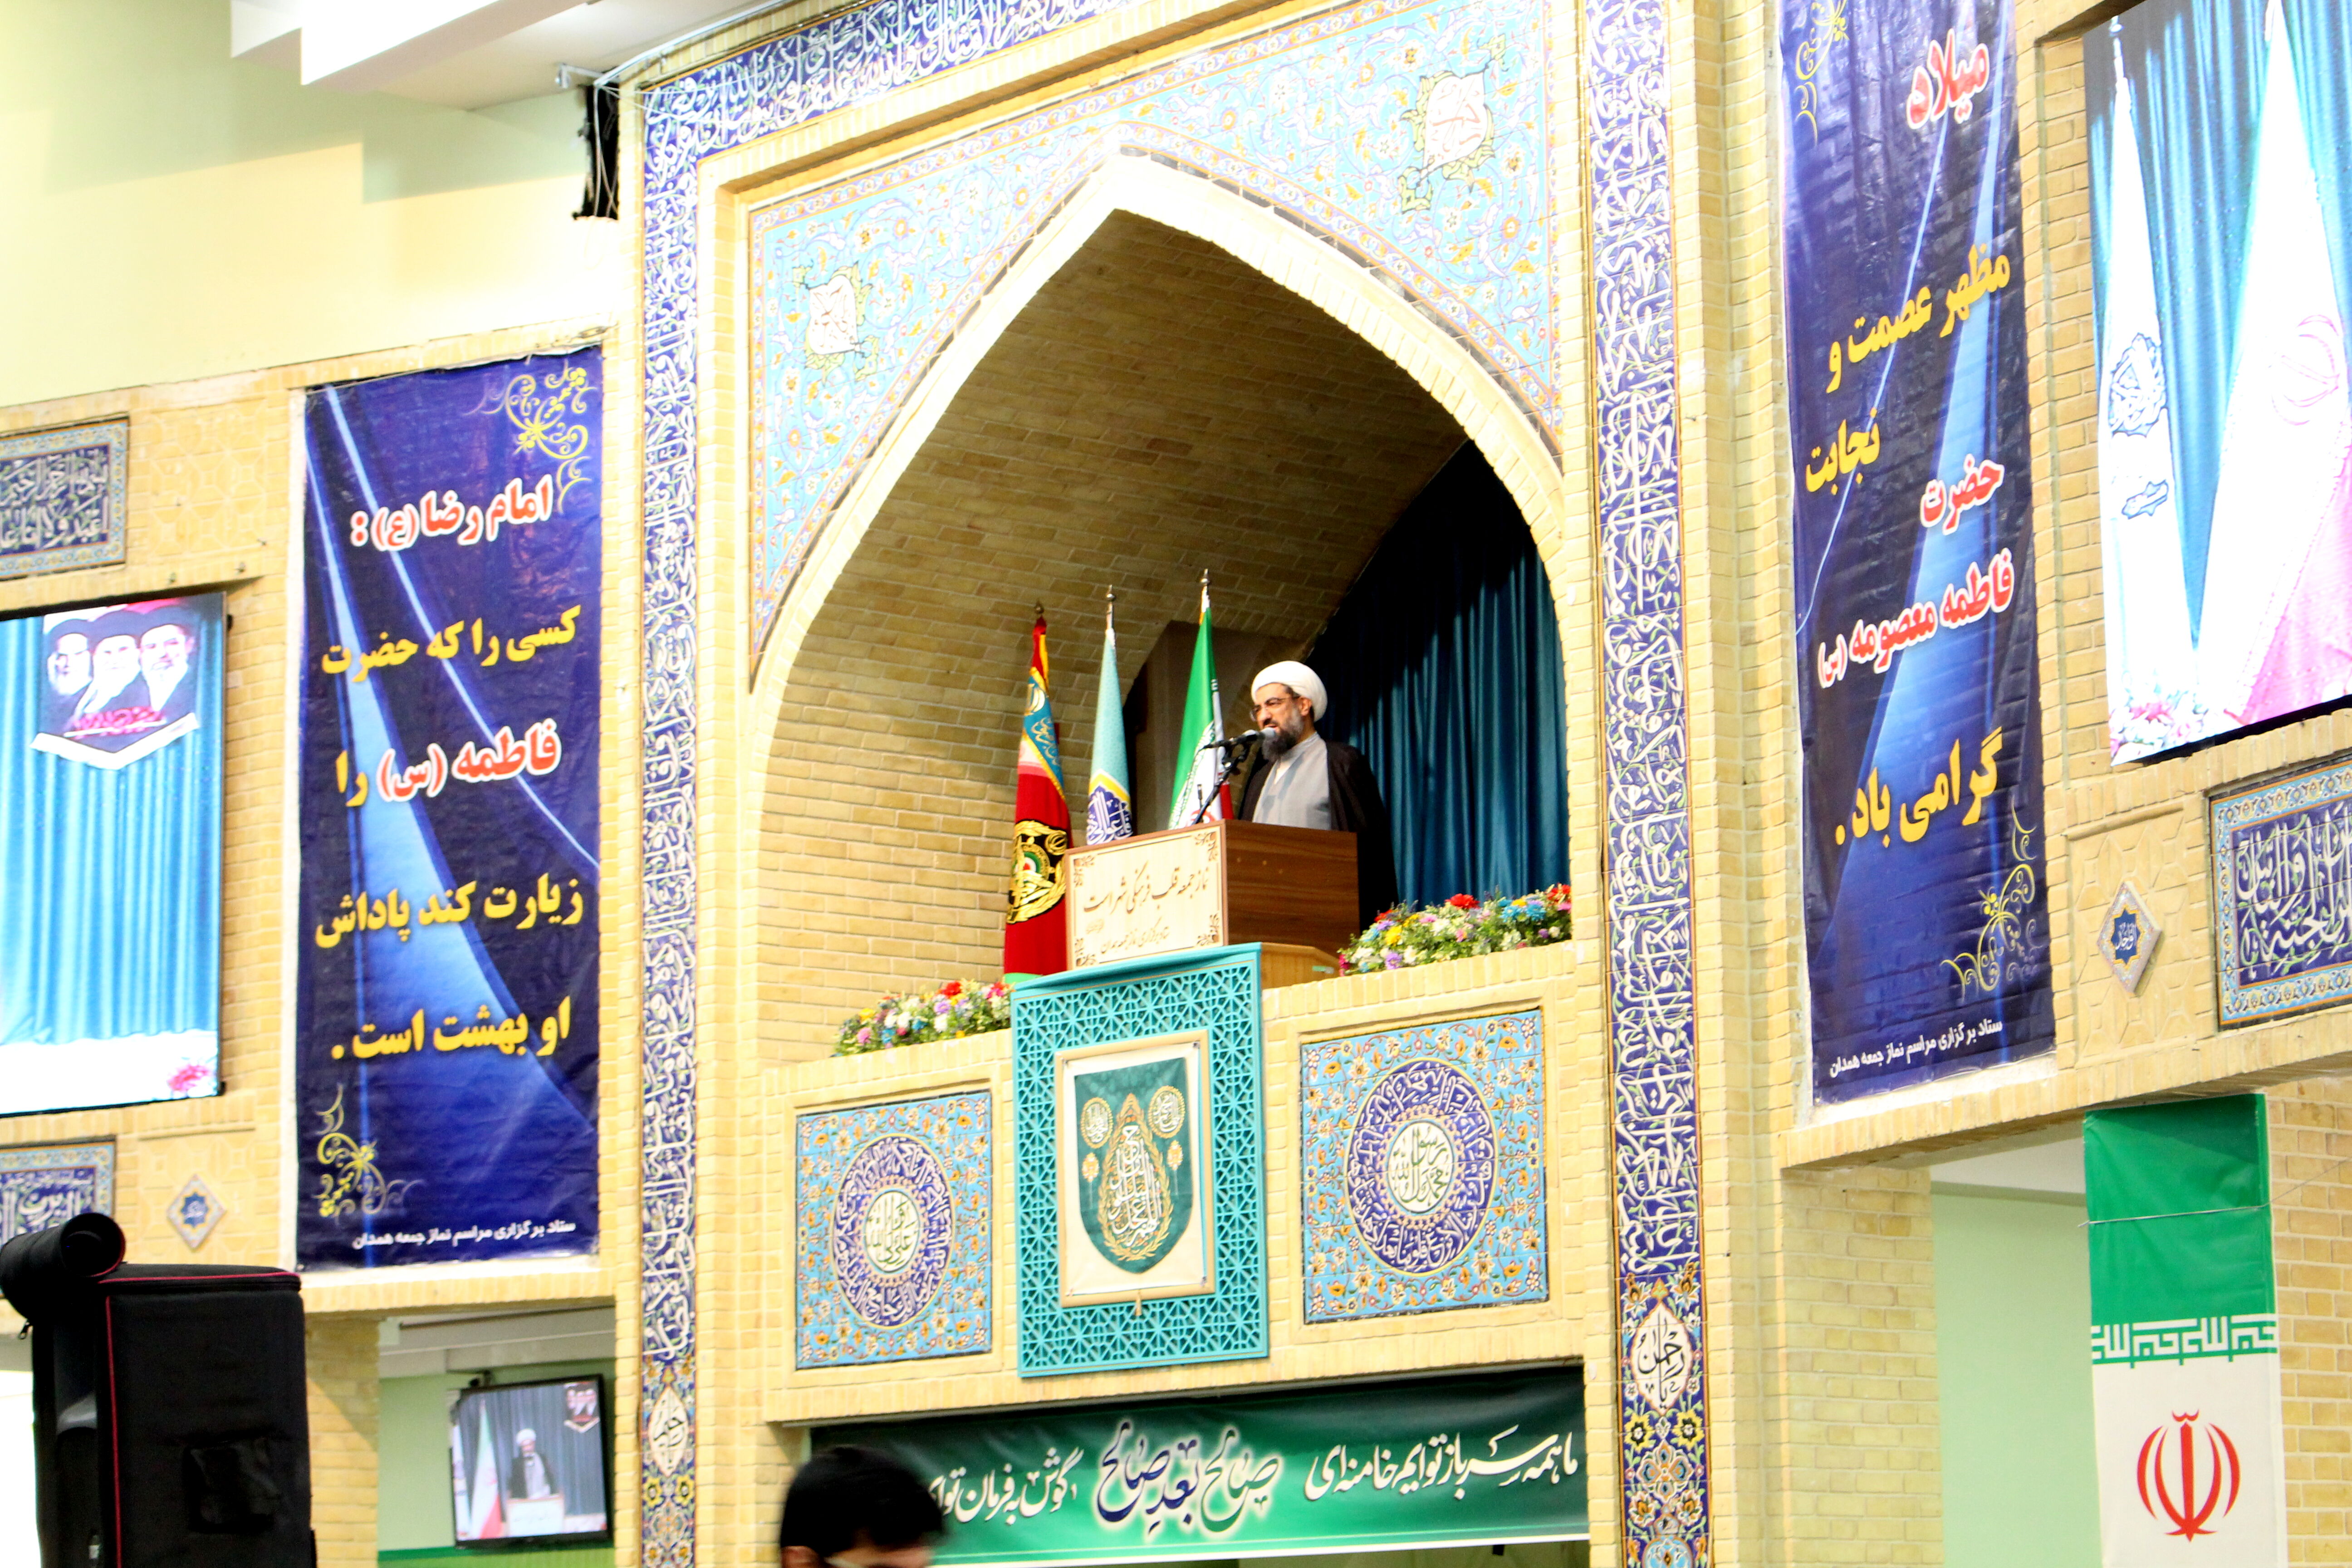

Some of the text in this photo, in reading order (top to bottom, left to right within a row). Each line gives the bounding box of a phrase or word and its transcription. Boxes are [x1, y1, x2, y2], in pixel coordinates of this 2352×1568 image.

[1906, 28, 1989, 129] میلاد
[1827, 243, 2011, 393] مظهر عصمت و
[1806, 407, 1881, 495] نجابت
[486, 475, 554, 542] امام
[1921, 454, 2004, 535] حضرت
[1940, 547, 2014, 629] فاطمه
[321, 605, 582, 682] کسی را که حضرت
[1849, 601, 1938, 674] معصومه
[335, 751, 368, 807] را
[452, 718, 562, 783] فاطمه
[1900, 727, 2003, 843] گرامی
[315, 873, 583, 949] زیارت کند پاداش
[1083, 860, 1209, 915] نماز جمعه قلب فرهنگی شهر است
[433, 1006, 529, 1056] بهشت
[537, 996, 571, 1056] او
[1886, 1042, 1904, 1064] نماز
[1906, 1034, 1937, 1064] مراسم
[1978, 1018, 2003, 1037] ستاد
[1829, 1054, 1860, 1078] همدان
[1861, 1051, 1884, 1067] جمعه
[352, 1233, 394, 1250] همدان
[394, 1232, 426, 1246] جمعه
[427, 1228, 452, 1245] نماز
[452, 1225, 493, 1247] مراسم
[547, 1220, 576, 1234] ستاد
[1021, 1446, 1084, 1517] گوش
[1098, 1421, 1171, 1523] صالح
[1201, 1426, 1281, 1532] صالح
[1521, 1436, 1563, 1485] همه
[1564, 1431, 1579, 1476] ما
